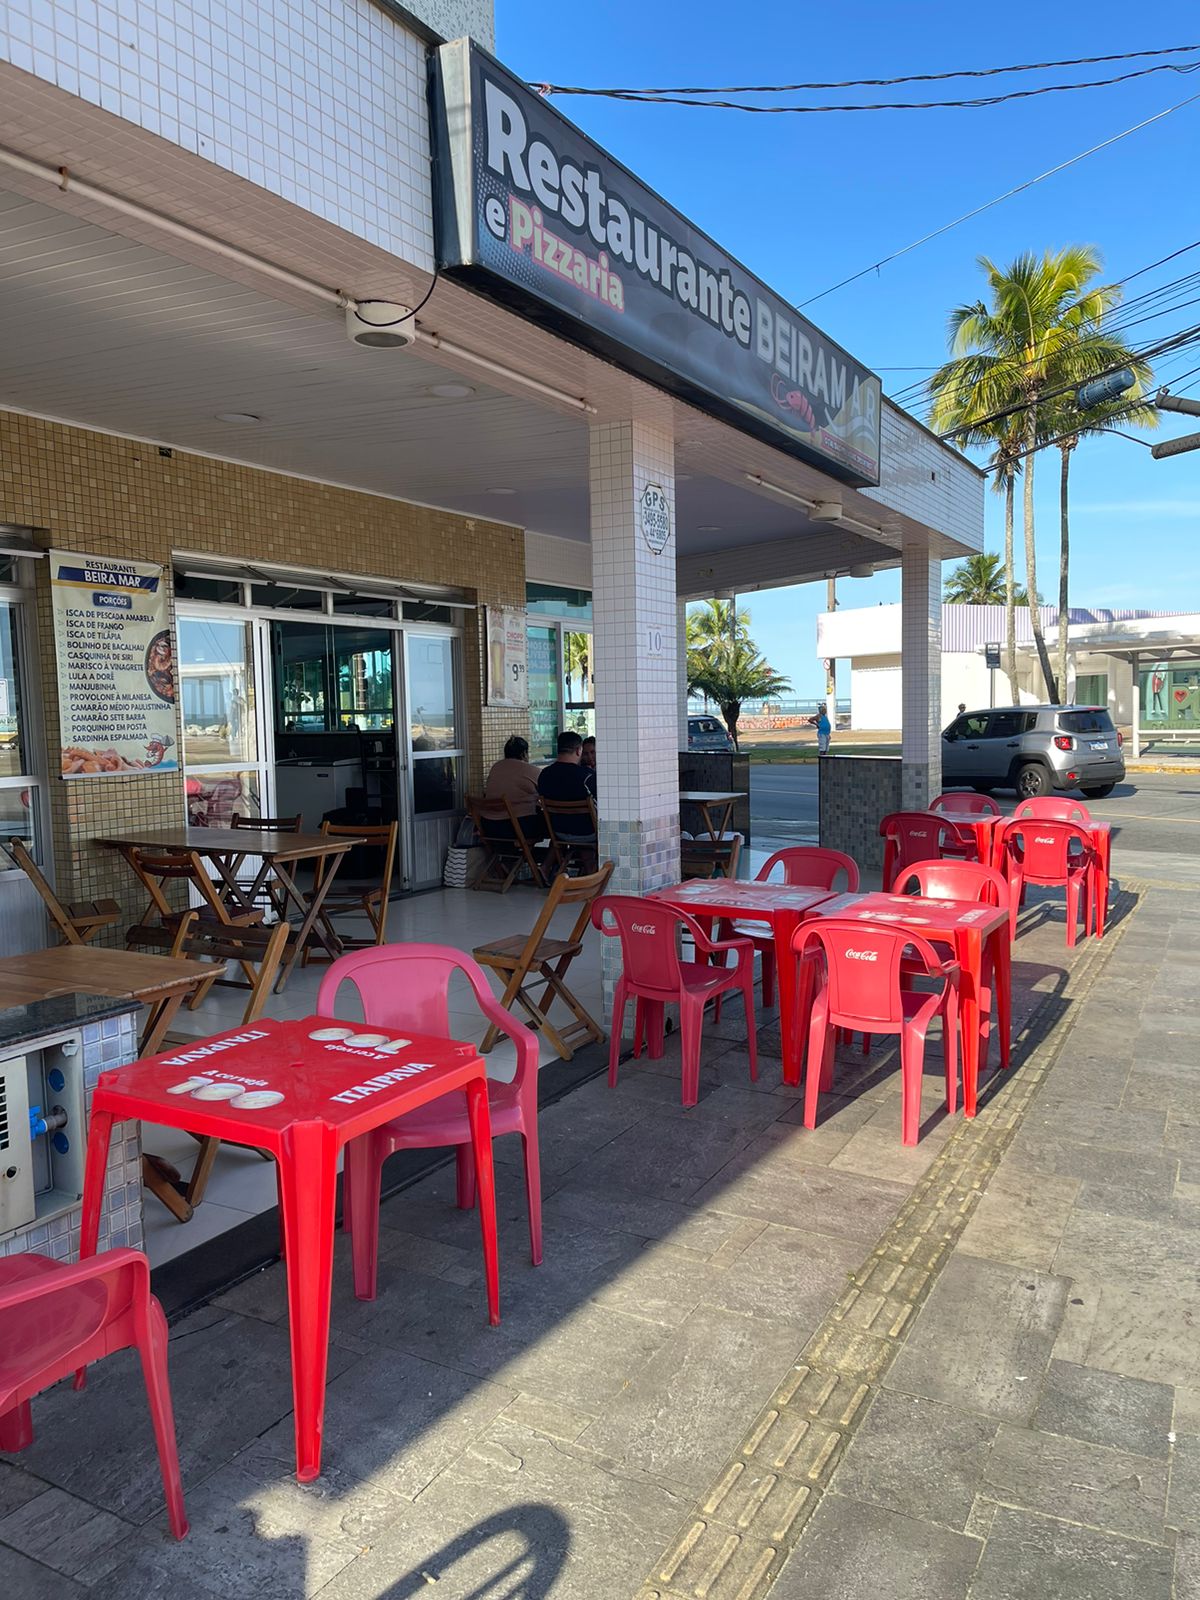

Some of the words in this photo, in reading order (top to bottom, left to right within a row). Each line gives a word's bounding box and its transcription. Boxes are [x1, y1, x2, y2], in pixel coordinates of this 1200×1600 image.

[484, 78, 752, 346] Restaurante
[485, 197, 505, 239] e
[511, 202, 625, 310] Pizzaria
[645, 491, 666, 511] GPS
[85, 560, 137, 574] RESTAURANTE
[84, 570, 117, 585] BEIRA
[118, 575, 141, 588] MAR
[99, 596, 128, 606] PORÇÕES
[66, 609, 84, 618] ISCA
[97, 611, 124, 621] PESCADA
[126, 614, 155, 623] AMARELA
[66, 620, 85, 628] ISCA
[86, 621, 96, 629] DE
[97, 622, 124, 631] FRANGO
[66, 630, 85, 639] ISCA
[87, 631, 96, 639] DE
[67, 641, 101, 650] BOLINHO
[102, 642, 111, 650] DE
[112, 643, 145, 652] BACALHAU
[649, 632, 661, 651] 10
[67, 652, 111, 661] CASQUINHA
[121, 653, 134, 661] SIRI
[68, 662, 103, 670] MARISCO
[69, 672, 88, 680] LULA
[69, 683, 117, 691] MANJUBINHA
[70, 693, 115, 701] PROVOLONE
[121, 693, 152, 701] MILANESA
[70, 702, 108, 711] CAMARÃO
[131, 703, 172, 711] PAULISTINHA
[71, 712, 109, 722] CAMARÃO
[110, 713, 125, 721] SETE
[126, 713, 146, 721] BARBA
[72, 724, 115, 733] PORQUINHO
[116, 723, 126, 731] EM
[73, 734, 109, 743] SARDINHA
[110, 733, 148, 742] ESPALMADA
[631, 922, 656, 935] Coca-Cola
[845, 948, 878, 962] Coca-Cola
[160, 1030, 271, 1066] ITAIPAVA
[216, 1070, 269, 1088] cerveja
[329, 1061, 437, 1105] ITAIPAVA
